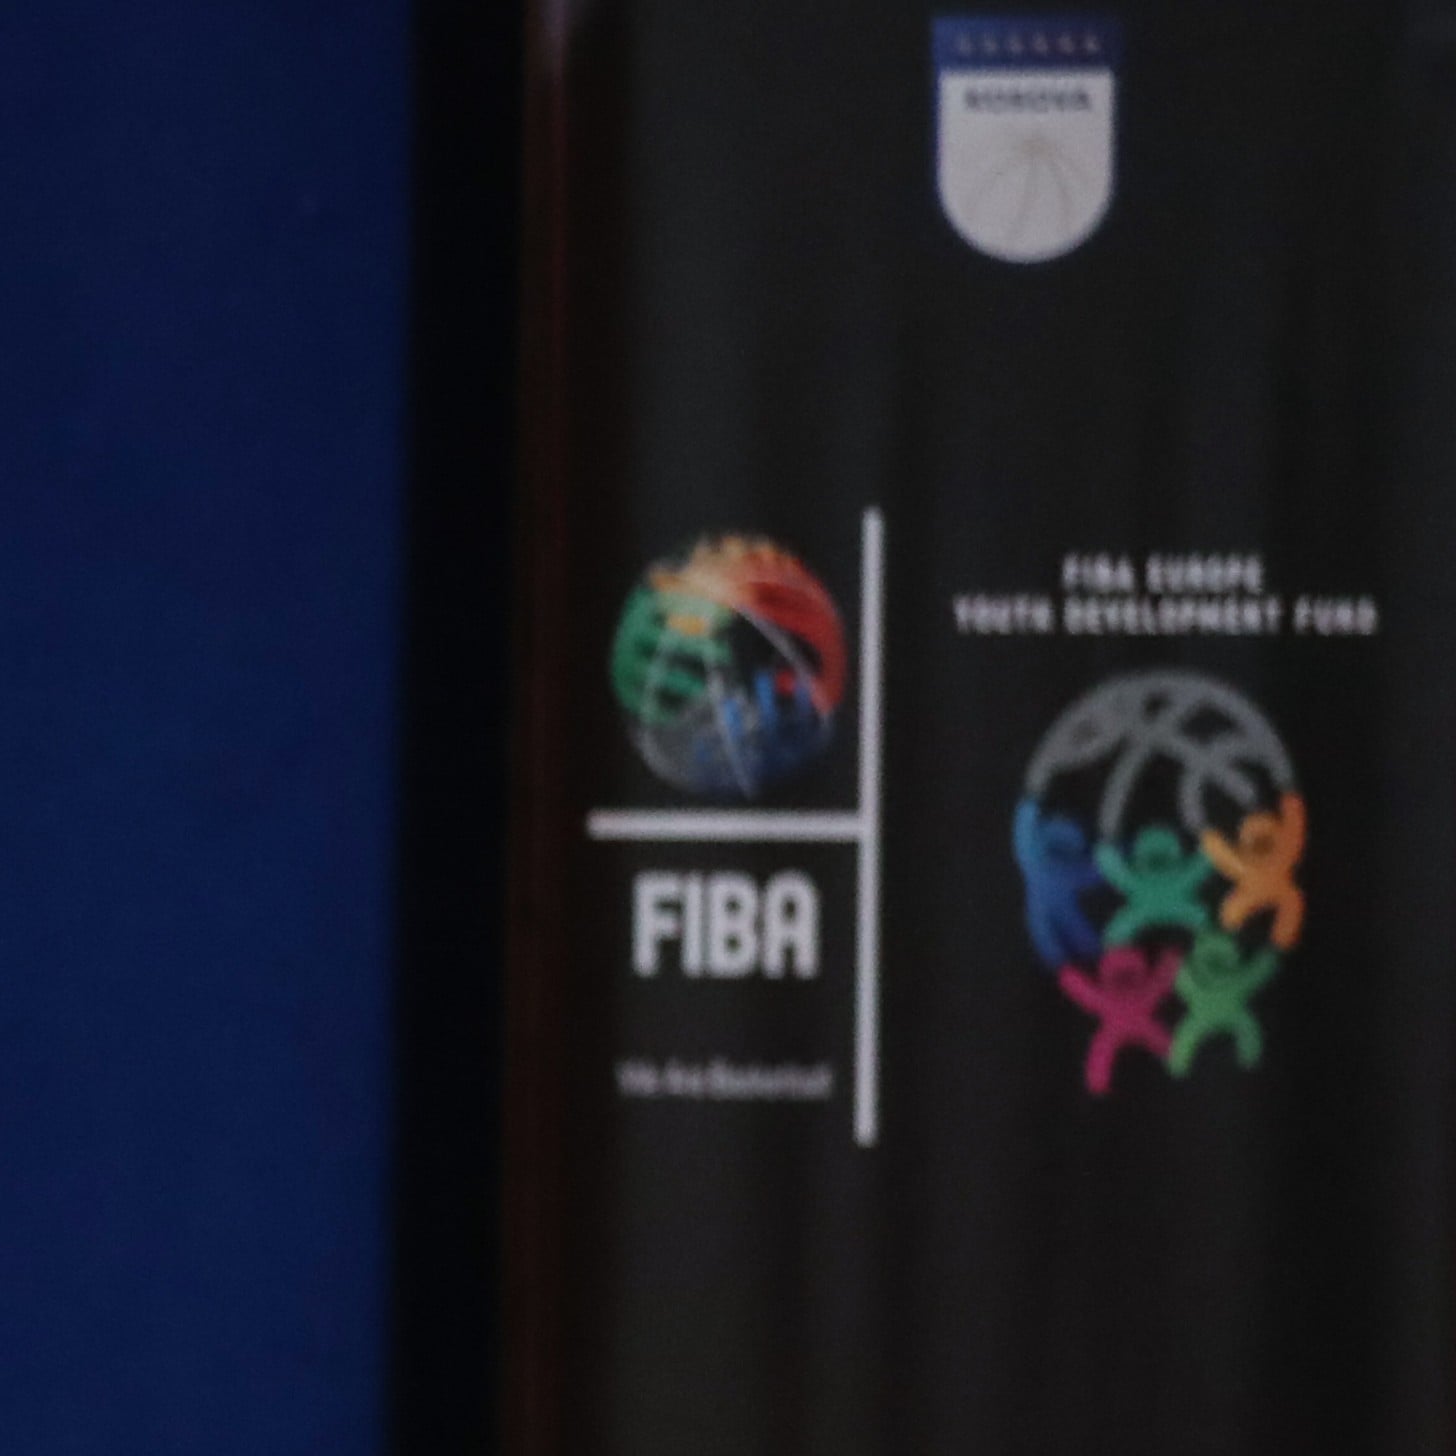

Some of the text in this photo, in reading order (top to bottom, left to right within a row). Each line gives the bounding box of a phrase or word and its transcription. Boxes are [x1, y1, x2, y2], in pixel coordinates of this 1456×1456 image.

[1062, 553, 1264, 594] FIBA EUROPE
[954, 595, 1378, 635] YOUTH DEVELOPMENT FUND
[632, 871, 820, 980] FIBA
